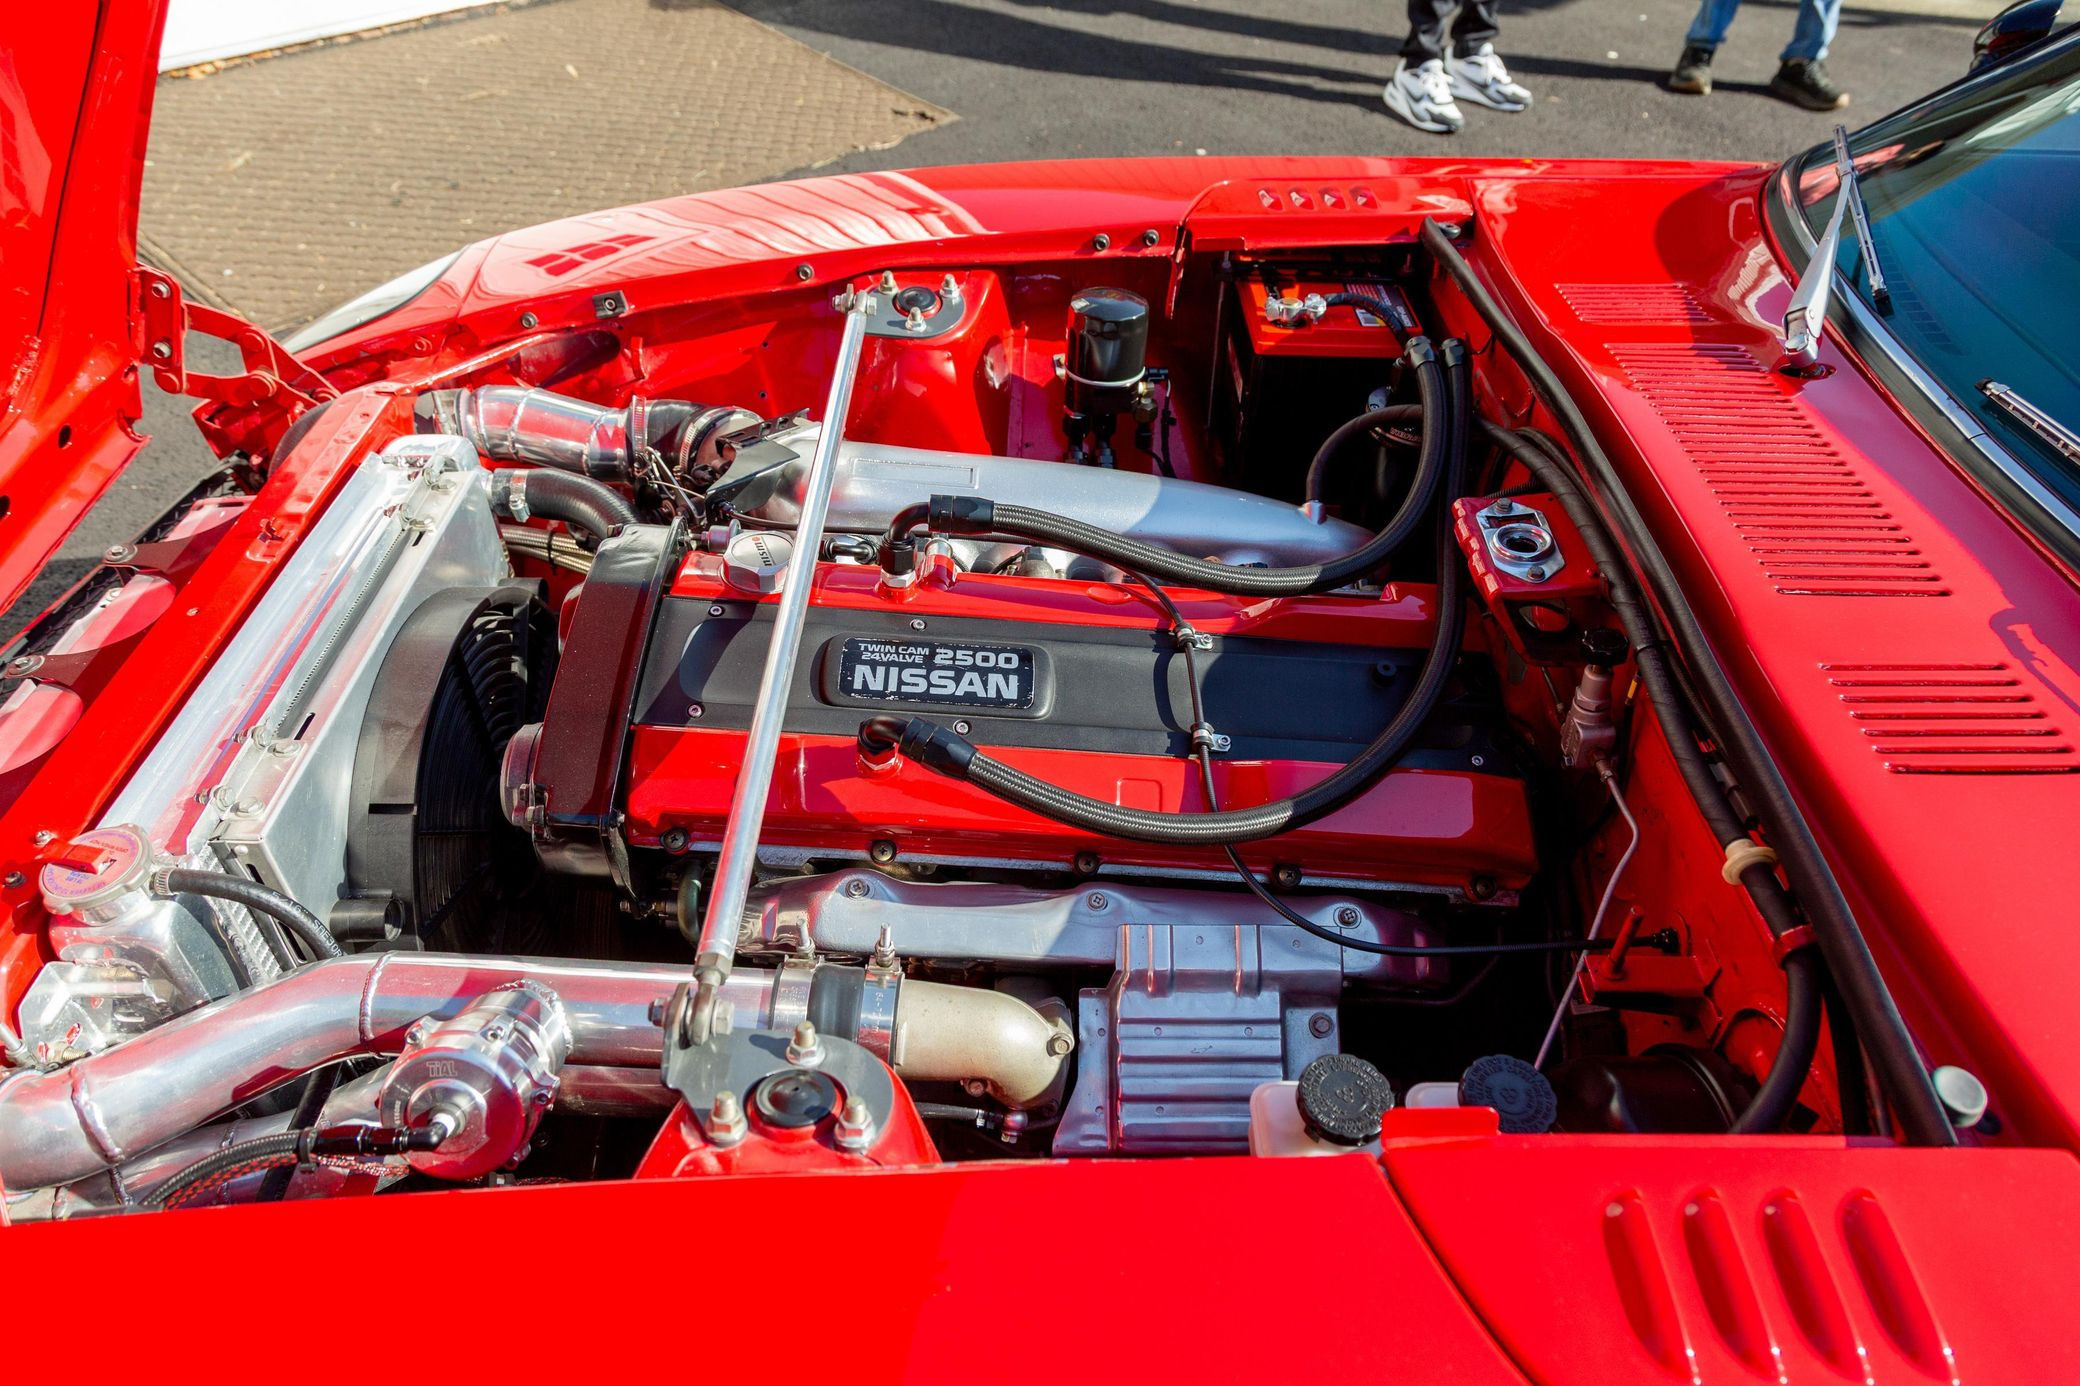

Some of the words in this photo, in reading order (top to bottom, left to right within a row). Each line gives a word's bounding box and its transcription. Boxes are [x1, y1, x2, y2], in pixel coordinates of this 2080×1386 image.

[752, 536, 773, 567] nismo
[858, 643, 896, 655] TWIN
[898, 645, 930, 656] CAM
[934, 649, 1019, 669] 2500
[852, 664, 1019, 700] NISSAN
